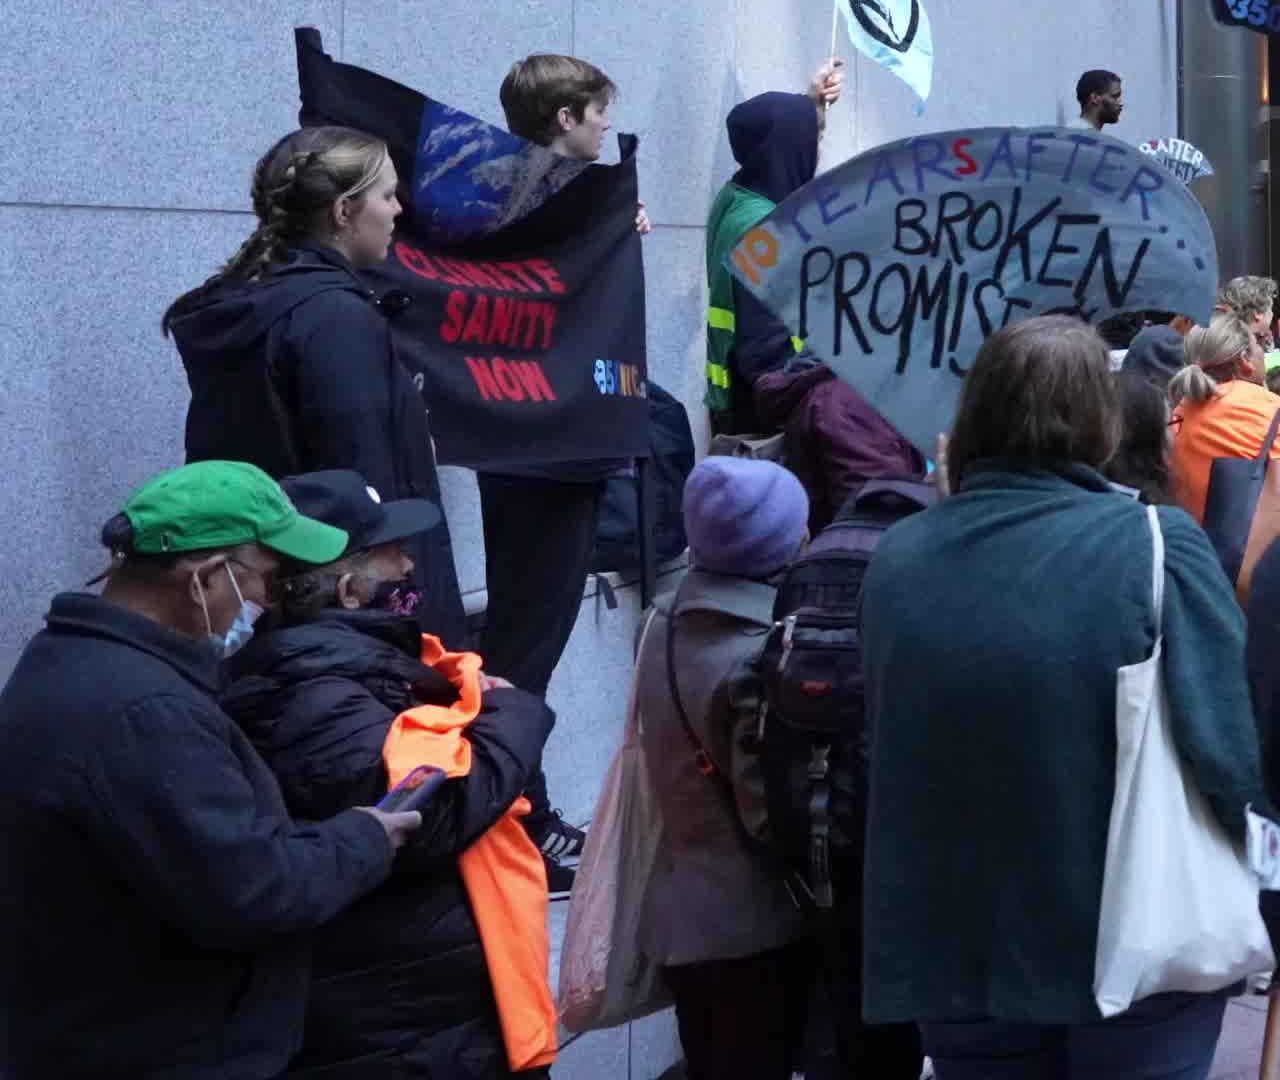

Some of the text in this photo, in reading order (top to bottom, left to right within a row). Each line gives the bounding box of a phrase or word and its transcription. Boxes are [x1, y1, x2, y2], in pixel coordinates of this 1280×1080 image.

[786, 137, 978, 244] YEARS
[394, 241, 568, 294] CLIMATE
[892, 186, 1152, 309] BROKEN
[440, 289, 557, 350] SANITY
[464, 356, 558, 402] NOW
